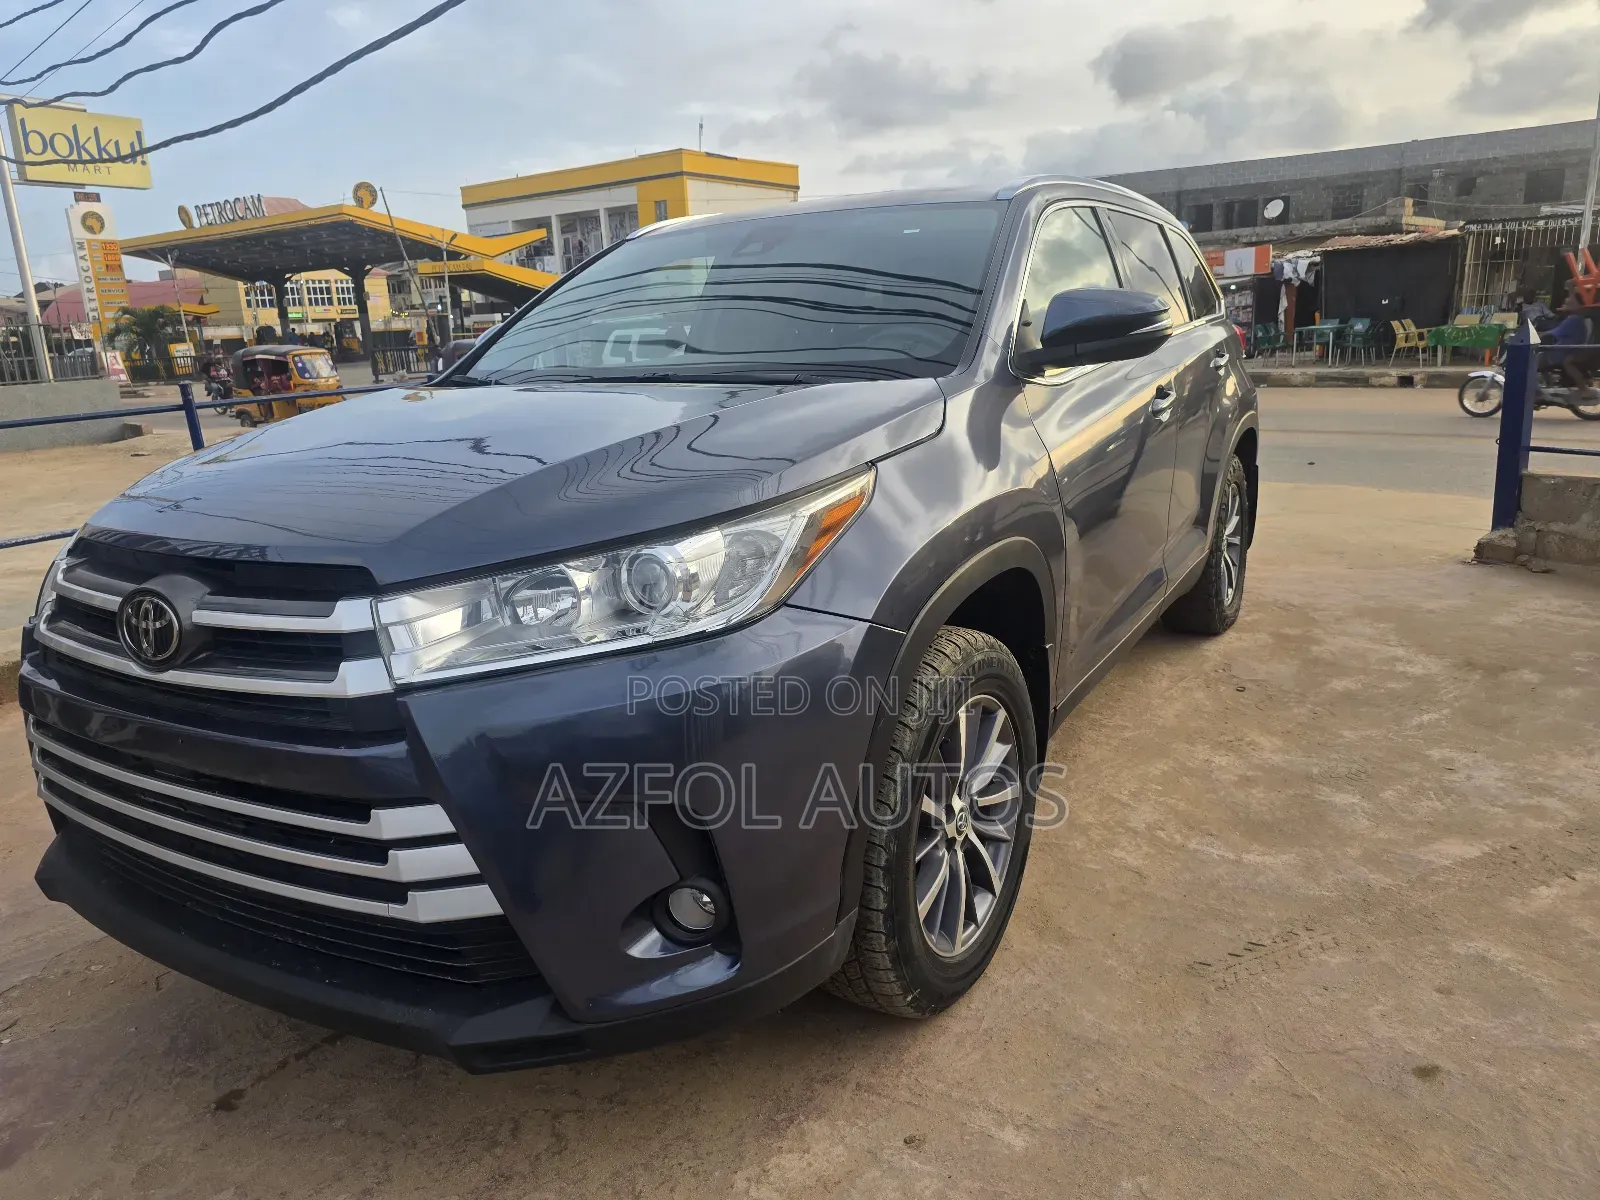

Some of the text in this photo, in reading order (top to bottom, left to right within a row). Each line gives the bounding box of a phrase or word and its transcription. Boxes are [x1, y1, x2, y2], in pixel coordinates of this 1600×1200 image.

[19, 117, 148, 166] bokku!
[67, 163, 112, 176] MART
[194, 193, 268, 227] PETROCAM
[76, 240, 99, 321] PETROCAM
